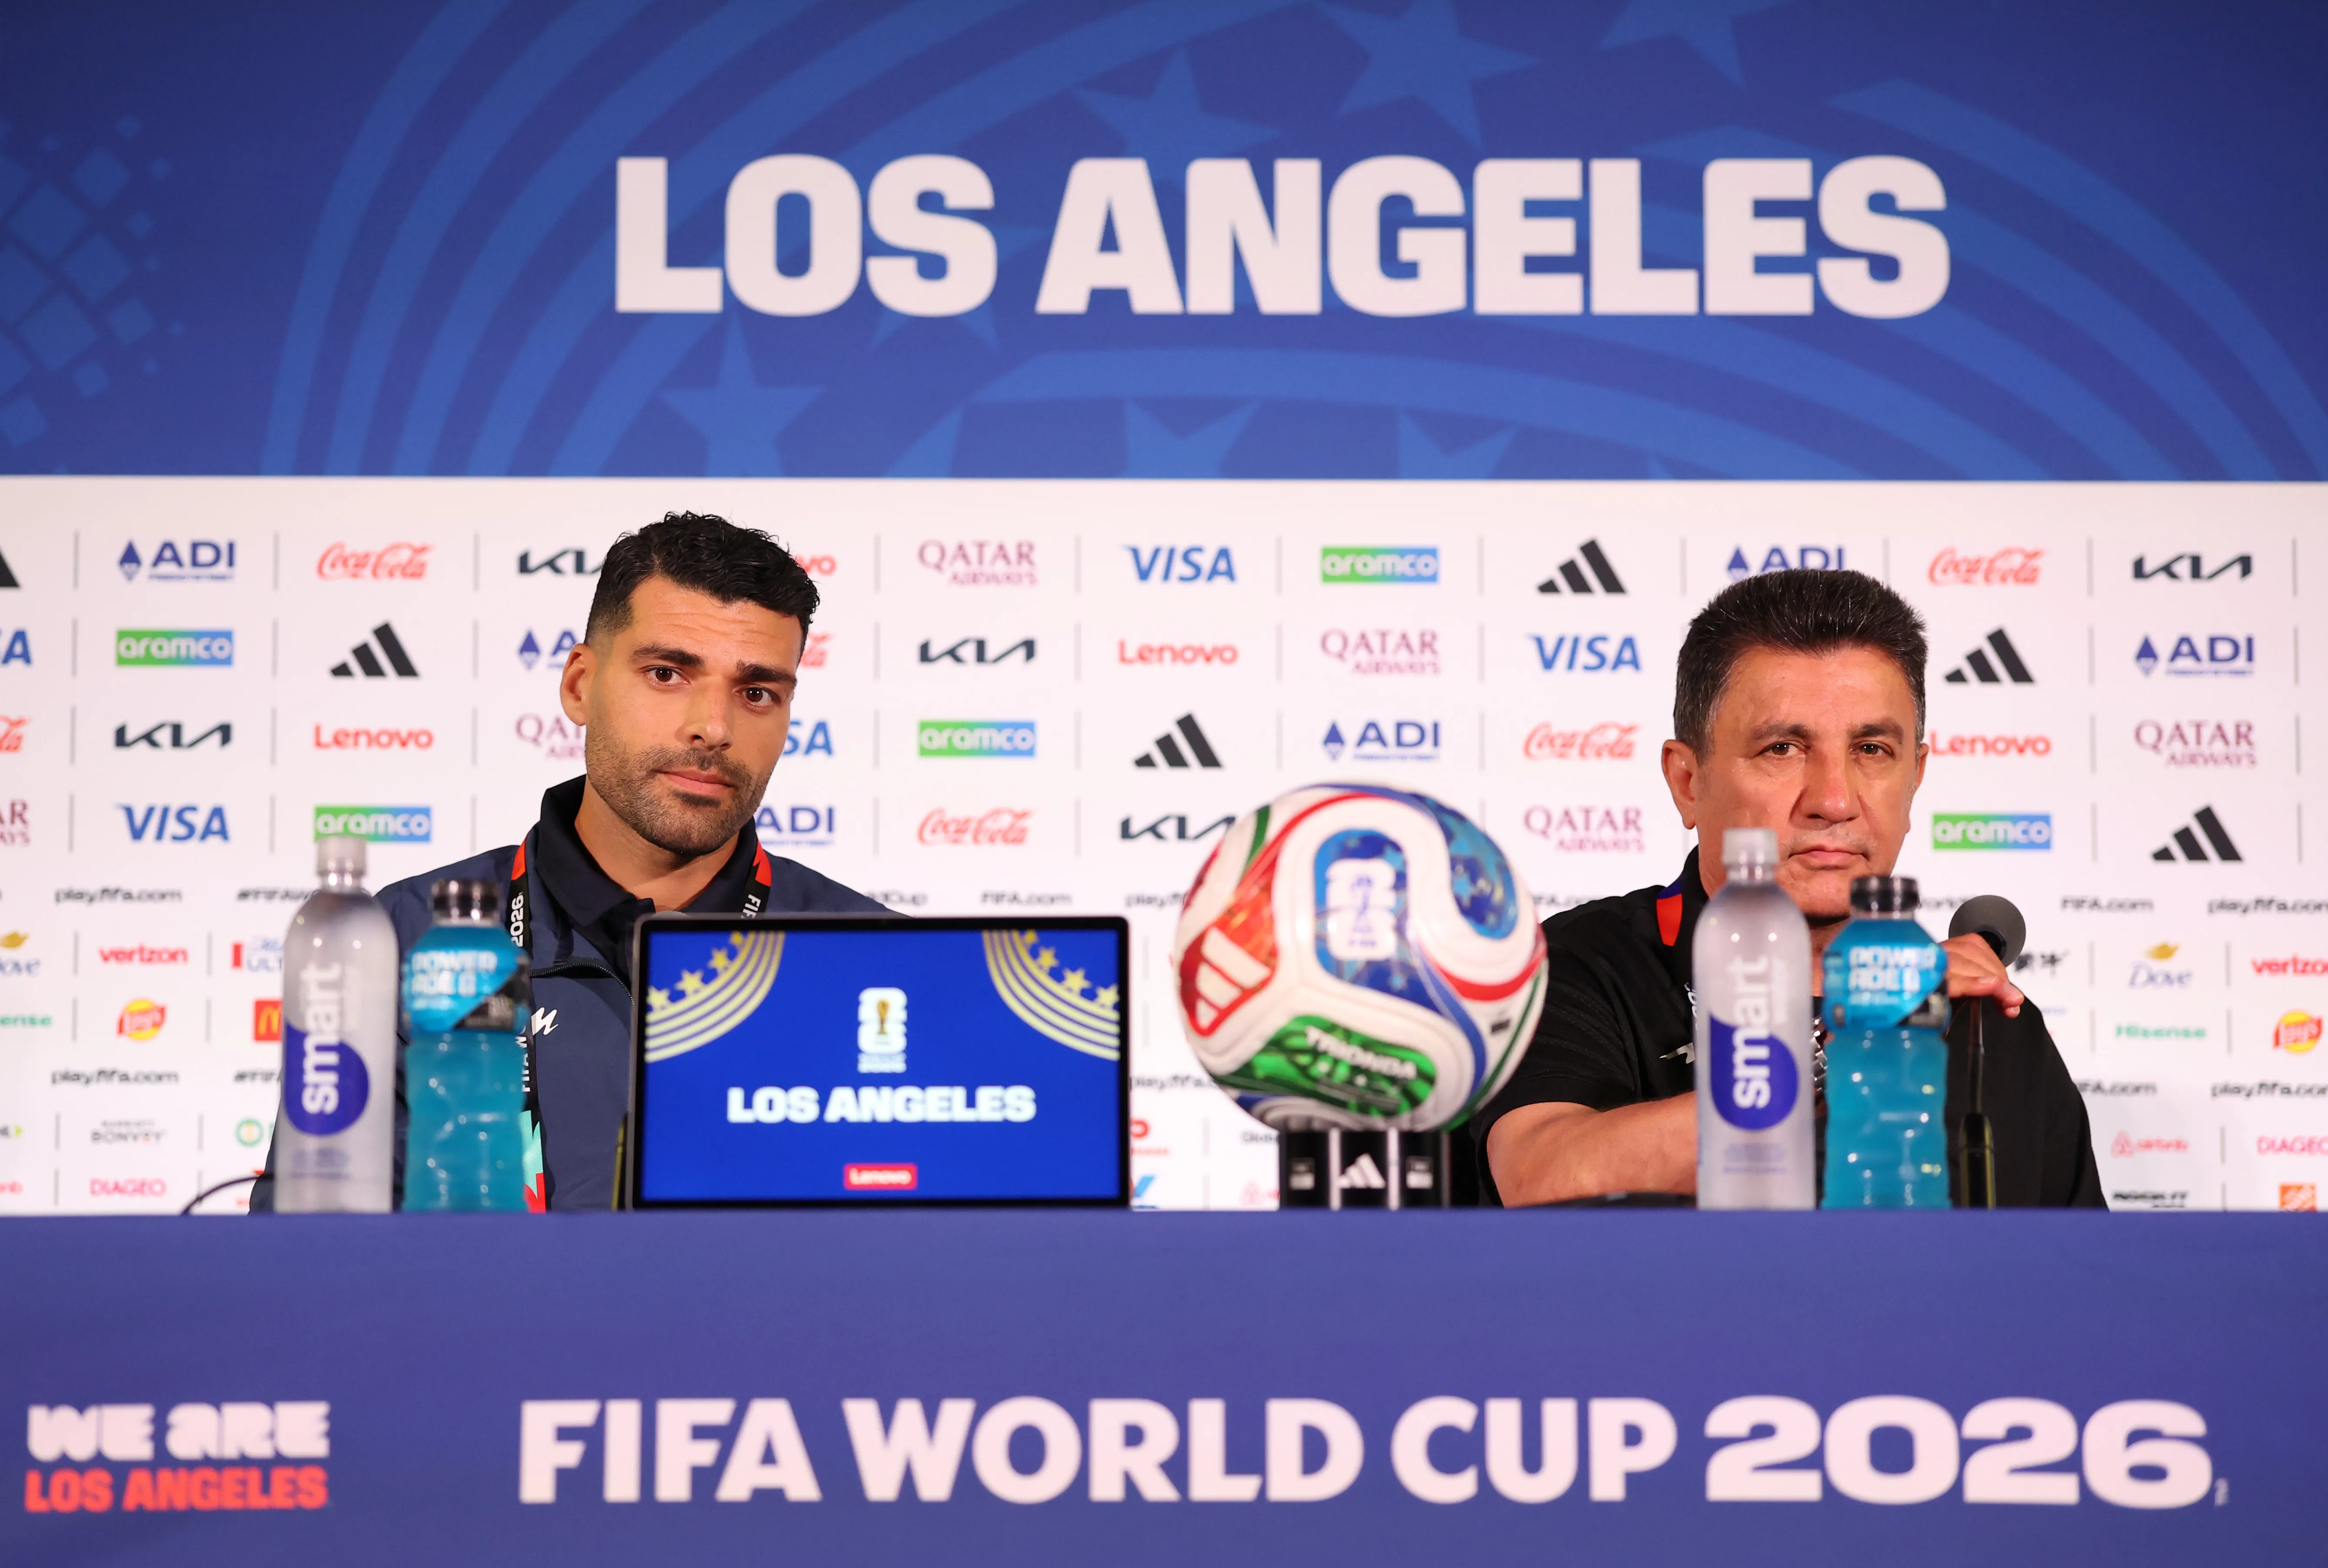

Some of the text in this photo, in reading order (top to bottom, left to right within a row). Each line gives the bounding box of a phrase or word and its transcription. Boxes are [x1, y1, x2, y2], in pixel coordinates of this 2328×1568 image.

[616, 154, 1950, 319] LOS ANGELES
[151, 541, 235, 568] ADI
[918, 539, 1037, 574] QATAR
[1128, 546, 1236, 582] VISA
[1324, 552, 1437, 577] aramco
[2133, 554, 2252, 580] KIA
[119, 637, 231, 660] aramco
[919, 638, 1036, 664] KIA
[1119, 640, 1238, 664] Lenovo
[1321, 629, 1439, 664] QATAR
[1532, 635, 1641, 671] VISA
[2169, 636, 2254, 663] ADI
[114, 723, 232, 748] KIA
[314, 724, 434, 749] Lenovo
[784, 721, 835, 756] SA
[921, 728, 1035, 751] aramco
[1356, 721, 1439, 748] ADI
[1930, 733, 2051, 757] Lenovo
[2135, 720, 2254, 756] QATAR
[2168, 753, 2257, 768] AIRWAYS
[121, 805, 229, 842] VISA
[317, 813, 430, 836] aramco
[756, 807, 835, 833] ADI
[1525, 807, 1643, 843] QATAR
[1935, 821, 2050, 844] aramco
[99, 945, 187, 964] verizon
[1848, 946, 1938, 969] POWER
[2129, 961, 2191, 987] Dove
[303, 961, 340, 1115] smart
[1728, 956, 1772, 1109] smart
[2116, 1025, 2206, 1039] Hisense
[727, 1085, 1036, 1123] LOS ANGELES
[90, 1179, 166, 1196] DIAGEO
[849, 1168, 912, 1185] Lenovo
[27, 1404, 155, 1461] WE
[520, 1395, 2212, 1508] FIFA WORLD CUP 2026
[24, 1465, 329, 1513] LOS ANGELES
